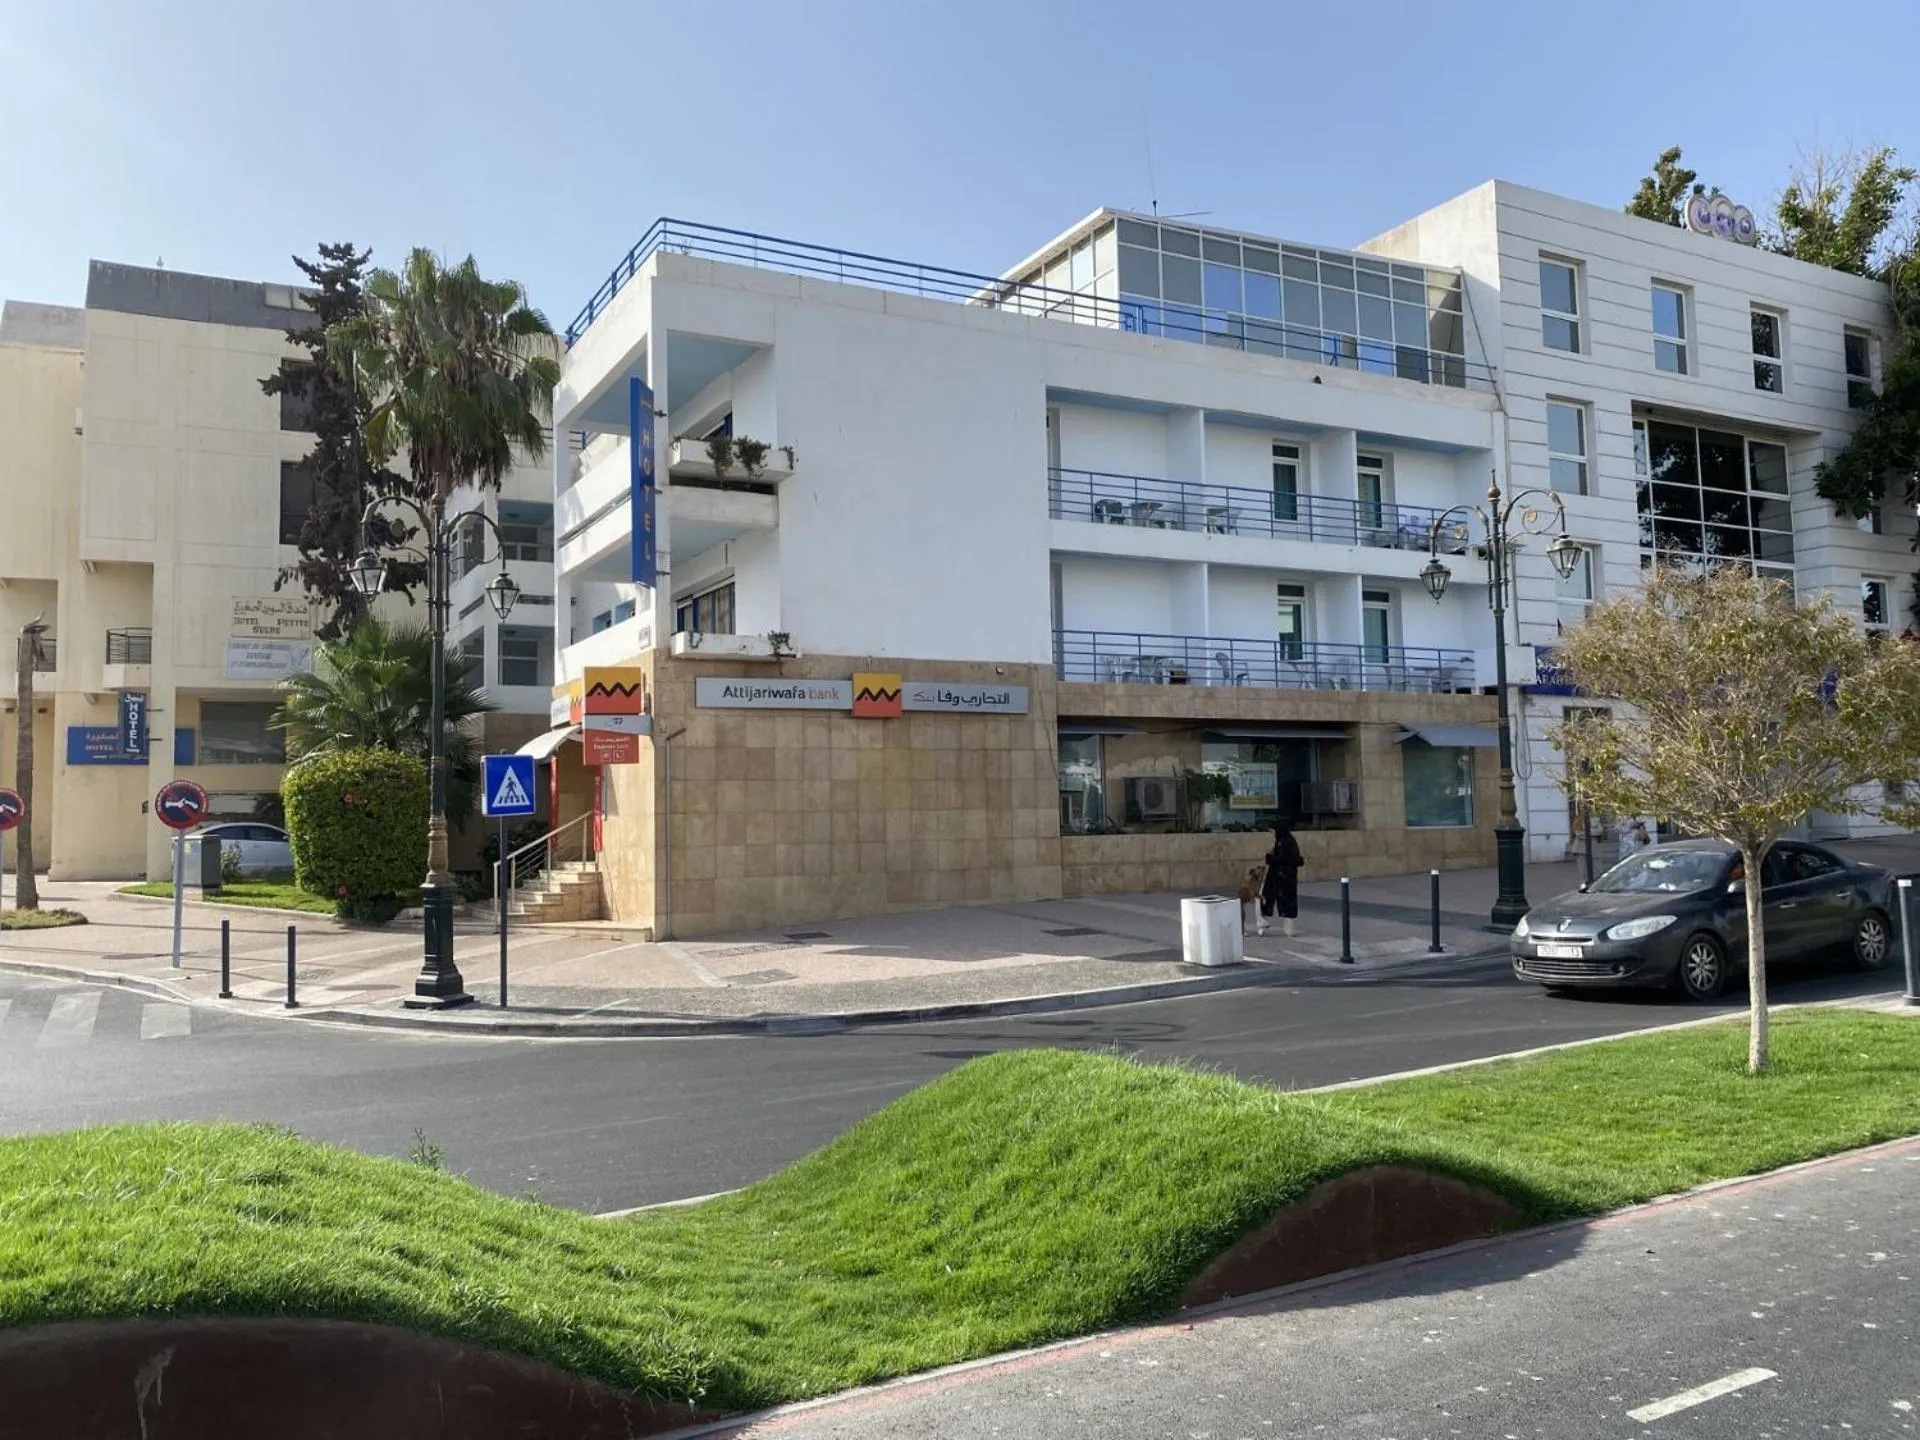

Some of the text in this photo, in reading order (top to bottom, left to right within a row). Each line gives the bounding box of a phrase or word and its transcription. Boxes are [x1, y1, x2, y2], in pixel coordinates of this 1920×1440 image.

[641, 428, 652, 560] HOTEL
[722, 685, 840, 702] Attijariwafa bank
[128, 702, 139, 748] HOTEL
